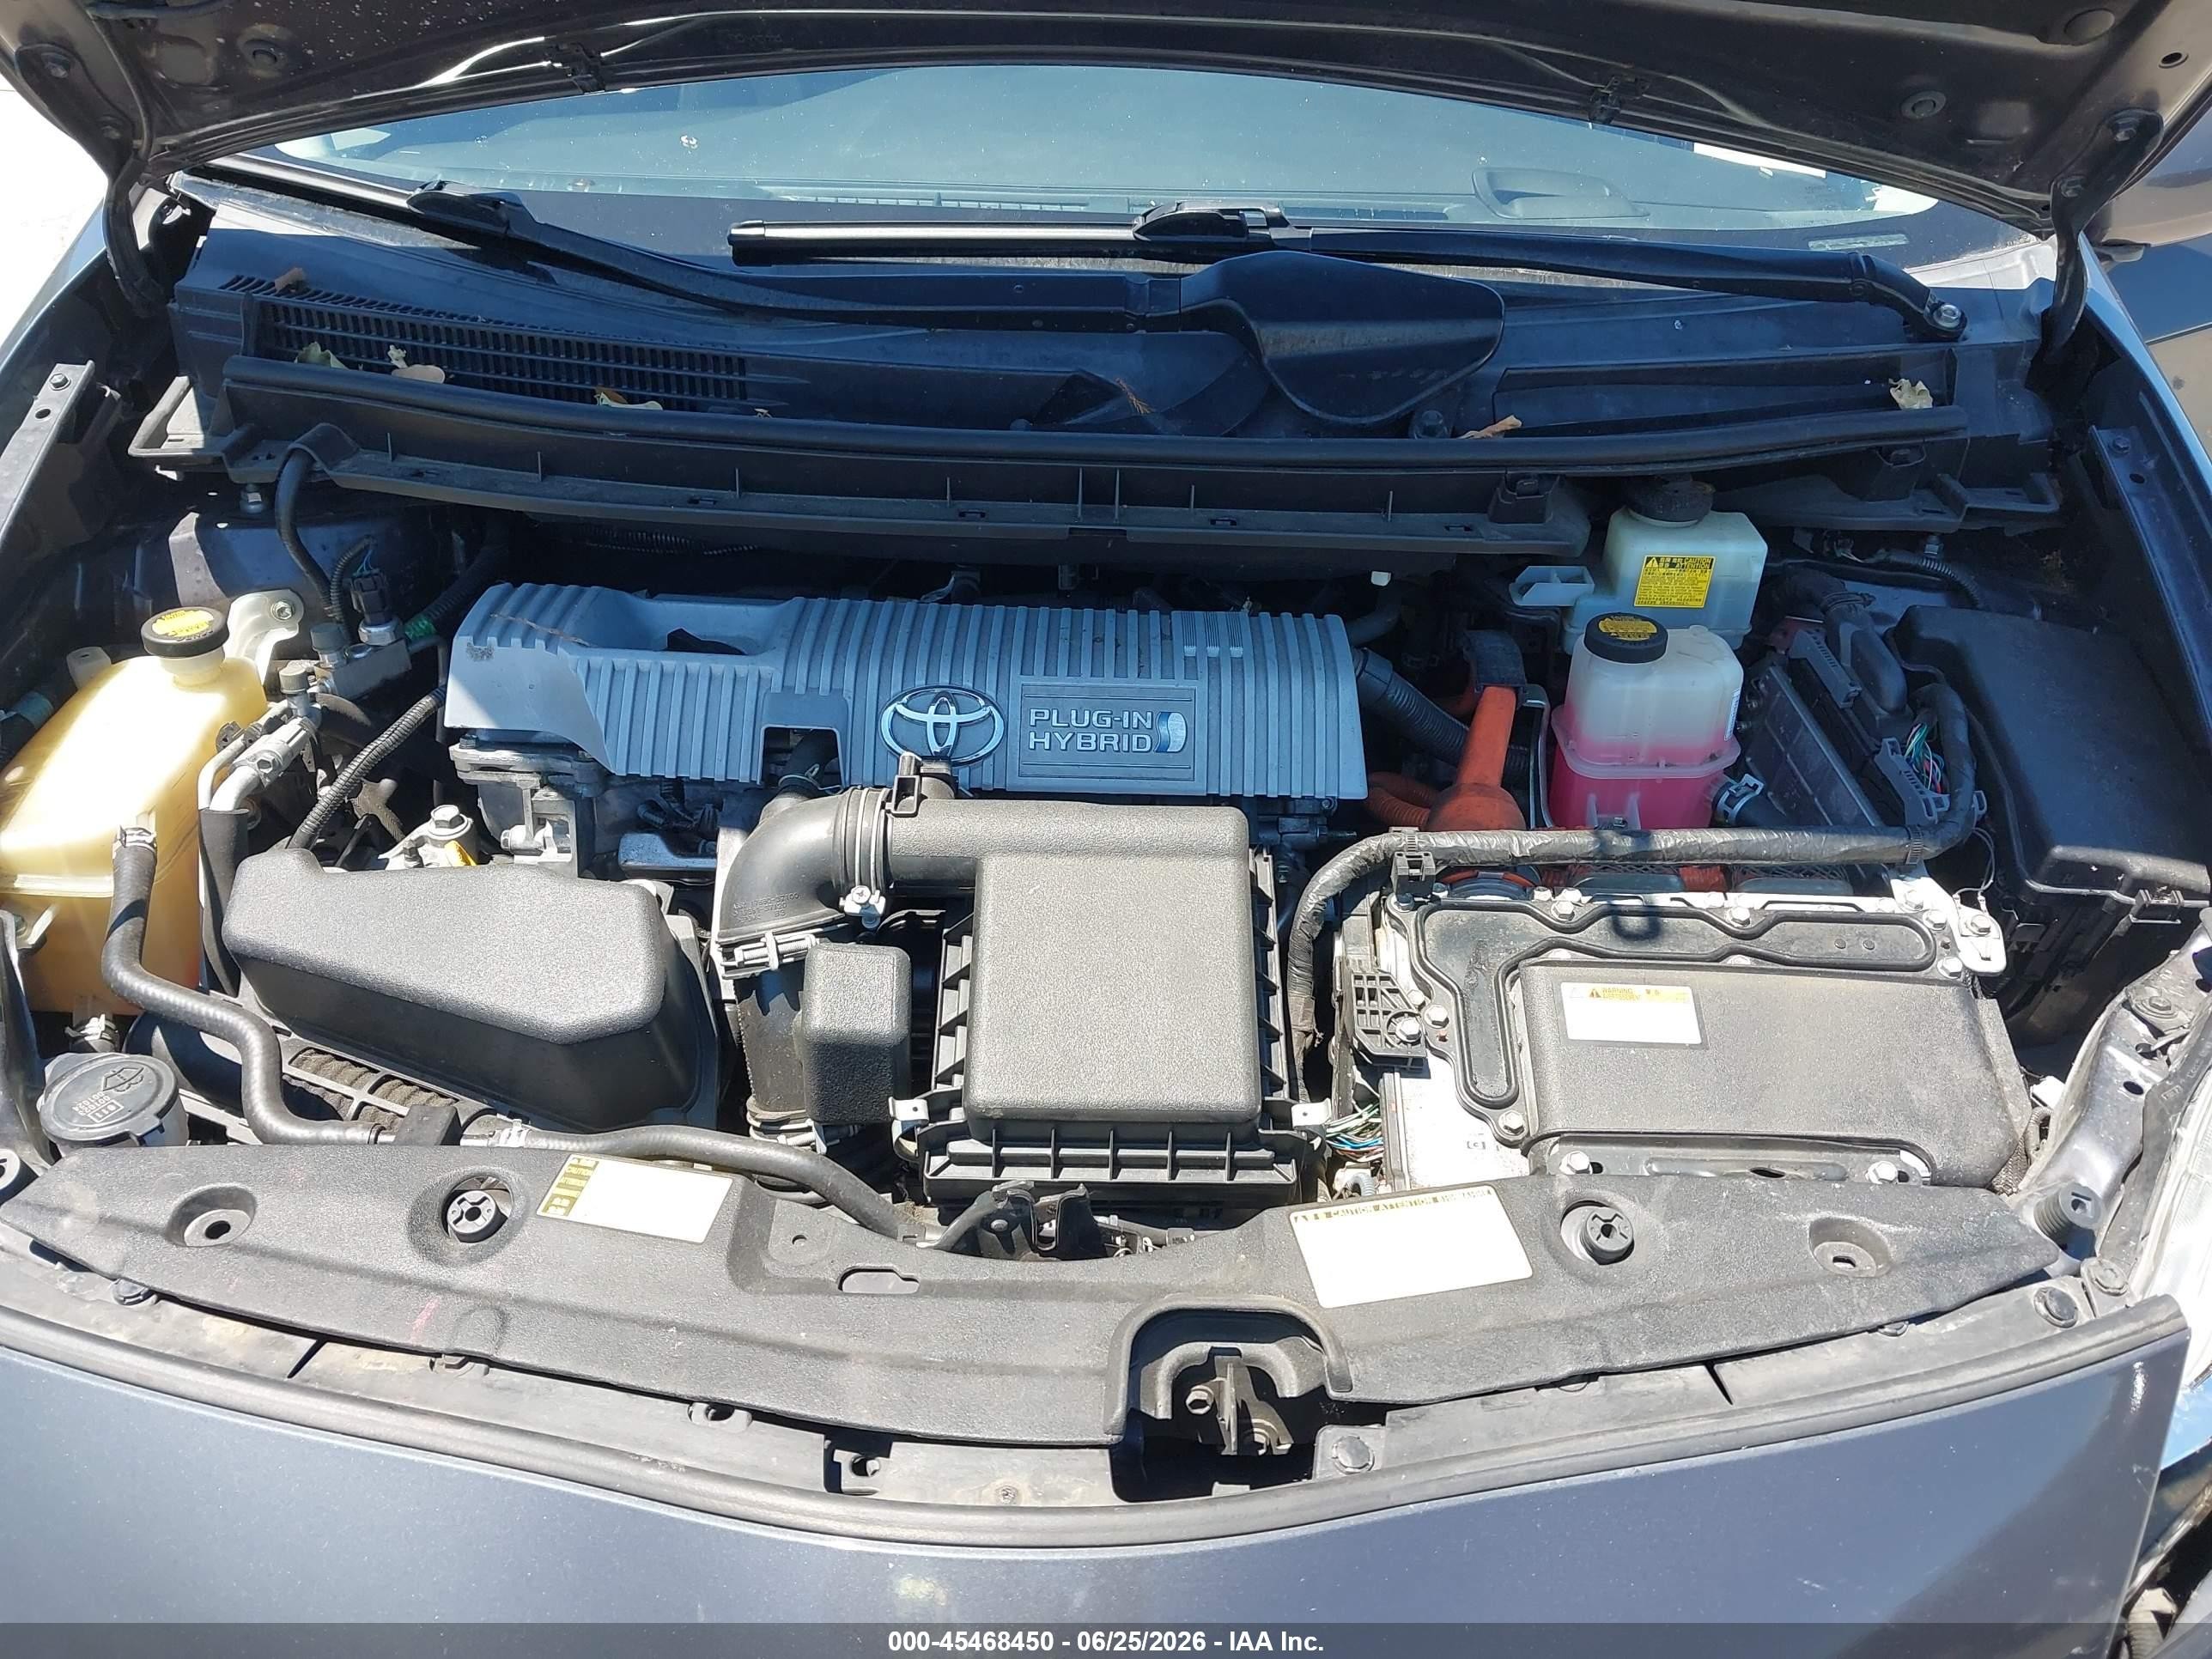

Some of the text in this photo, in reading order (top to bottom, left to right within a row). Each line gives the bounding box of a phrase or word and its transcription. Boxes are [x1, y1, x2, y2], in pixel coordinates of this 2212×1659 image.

[1029, 708, 1153, 730] PLUG-IN
[1029, 730, 1152, 753] HYBRID
[1334, 1203, 1374, 1218] CAUTION
